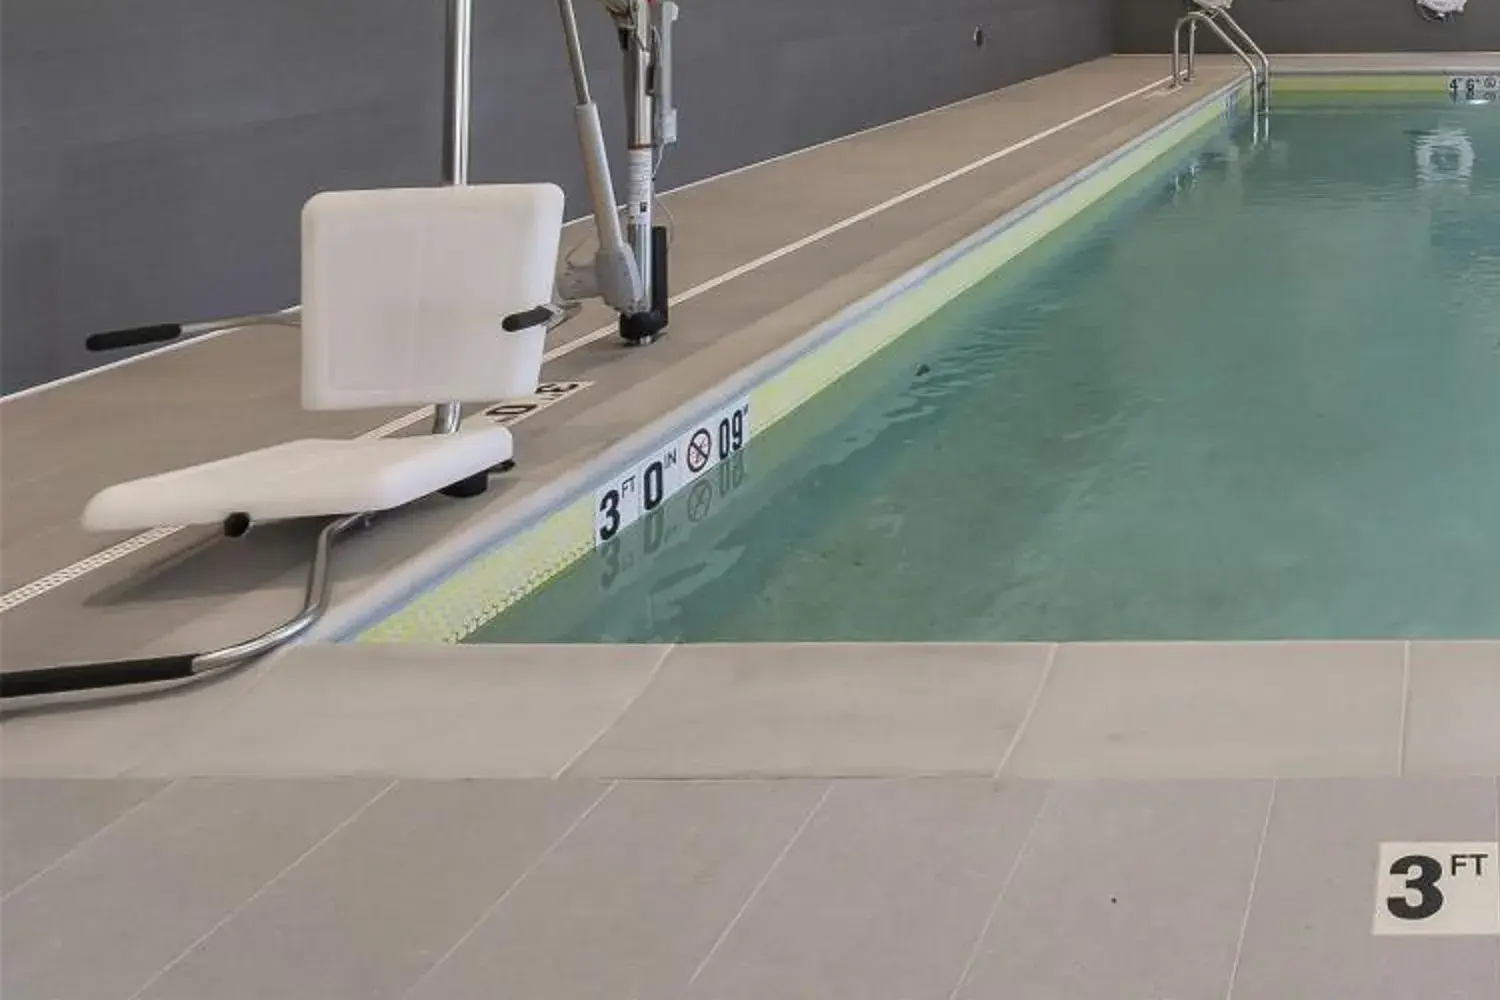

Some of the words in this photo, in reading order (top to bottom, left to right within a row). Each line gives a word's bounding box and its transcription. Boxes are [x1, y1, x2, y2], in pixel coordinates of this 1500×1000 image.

[600, 490, 620, 540] 3
[621, 475, 636, 498] FT
[643, 461, 663, 510] 0
[1386, 855, 1444, 920] 3
[1450, 854, 1488, 876] FT
